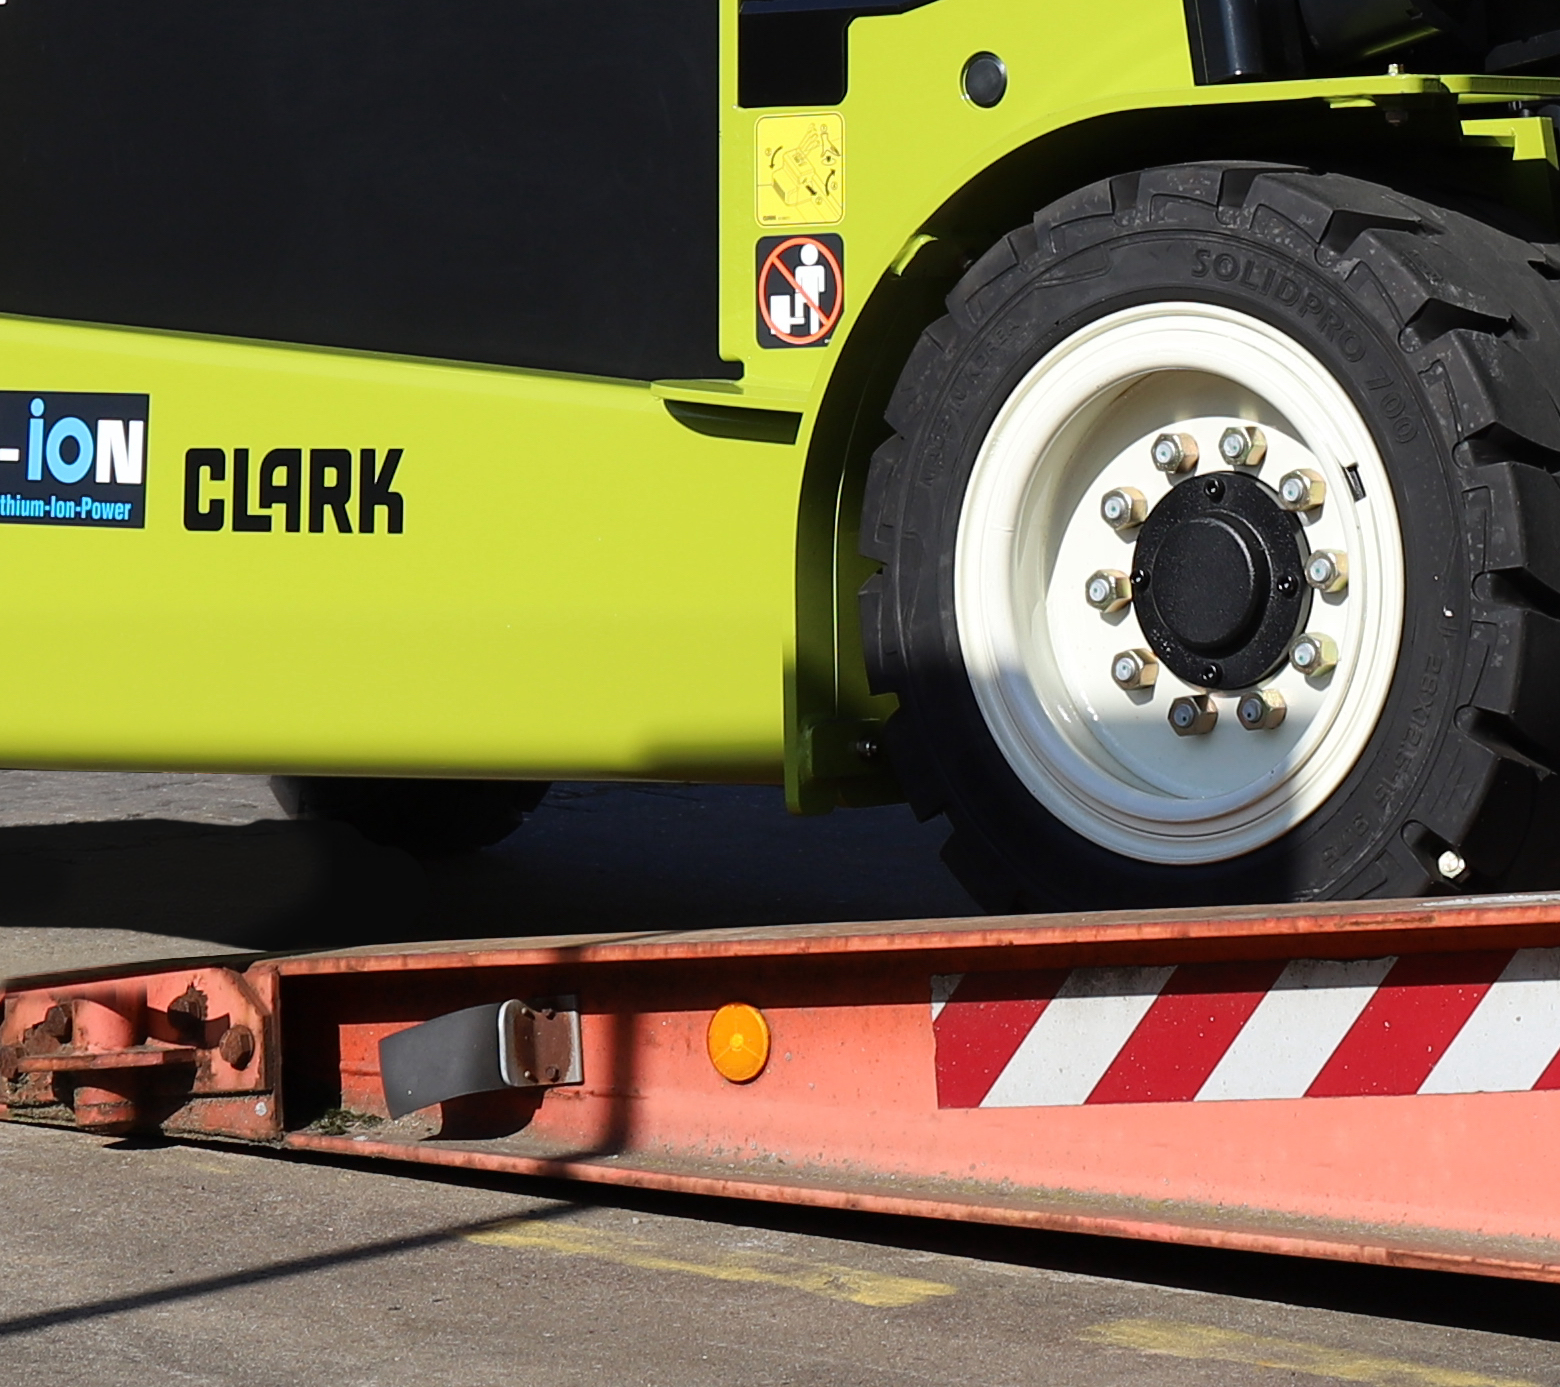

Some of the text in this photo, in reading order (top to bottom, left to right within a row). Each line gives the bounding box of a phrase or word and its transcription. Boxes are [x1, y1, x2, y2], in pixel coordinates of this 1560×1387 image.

[1191, 247, 1419, 444] SOLIDPRO 700
[184, 447, 404, 534] CLARK
